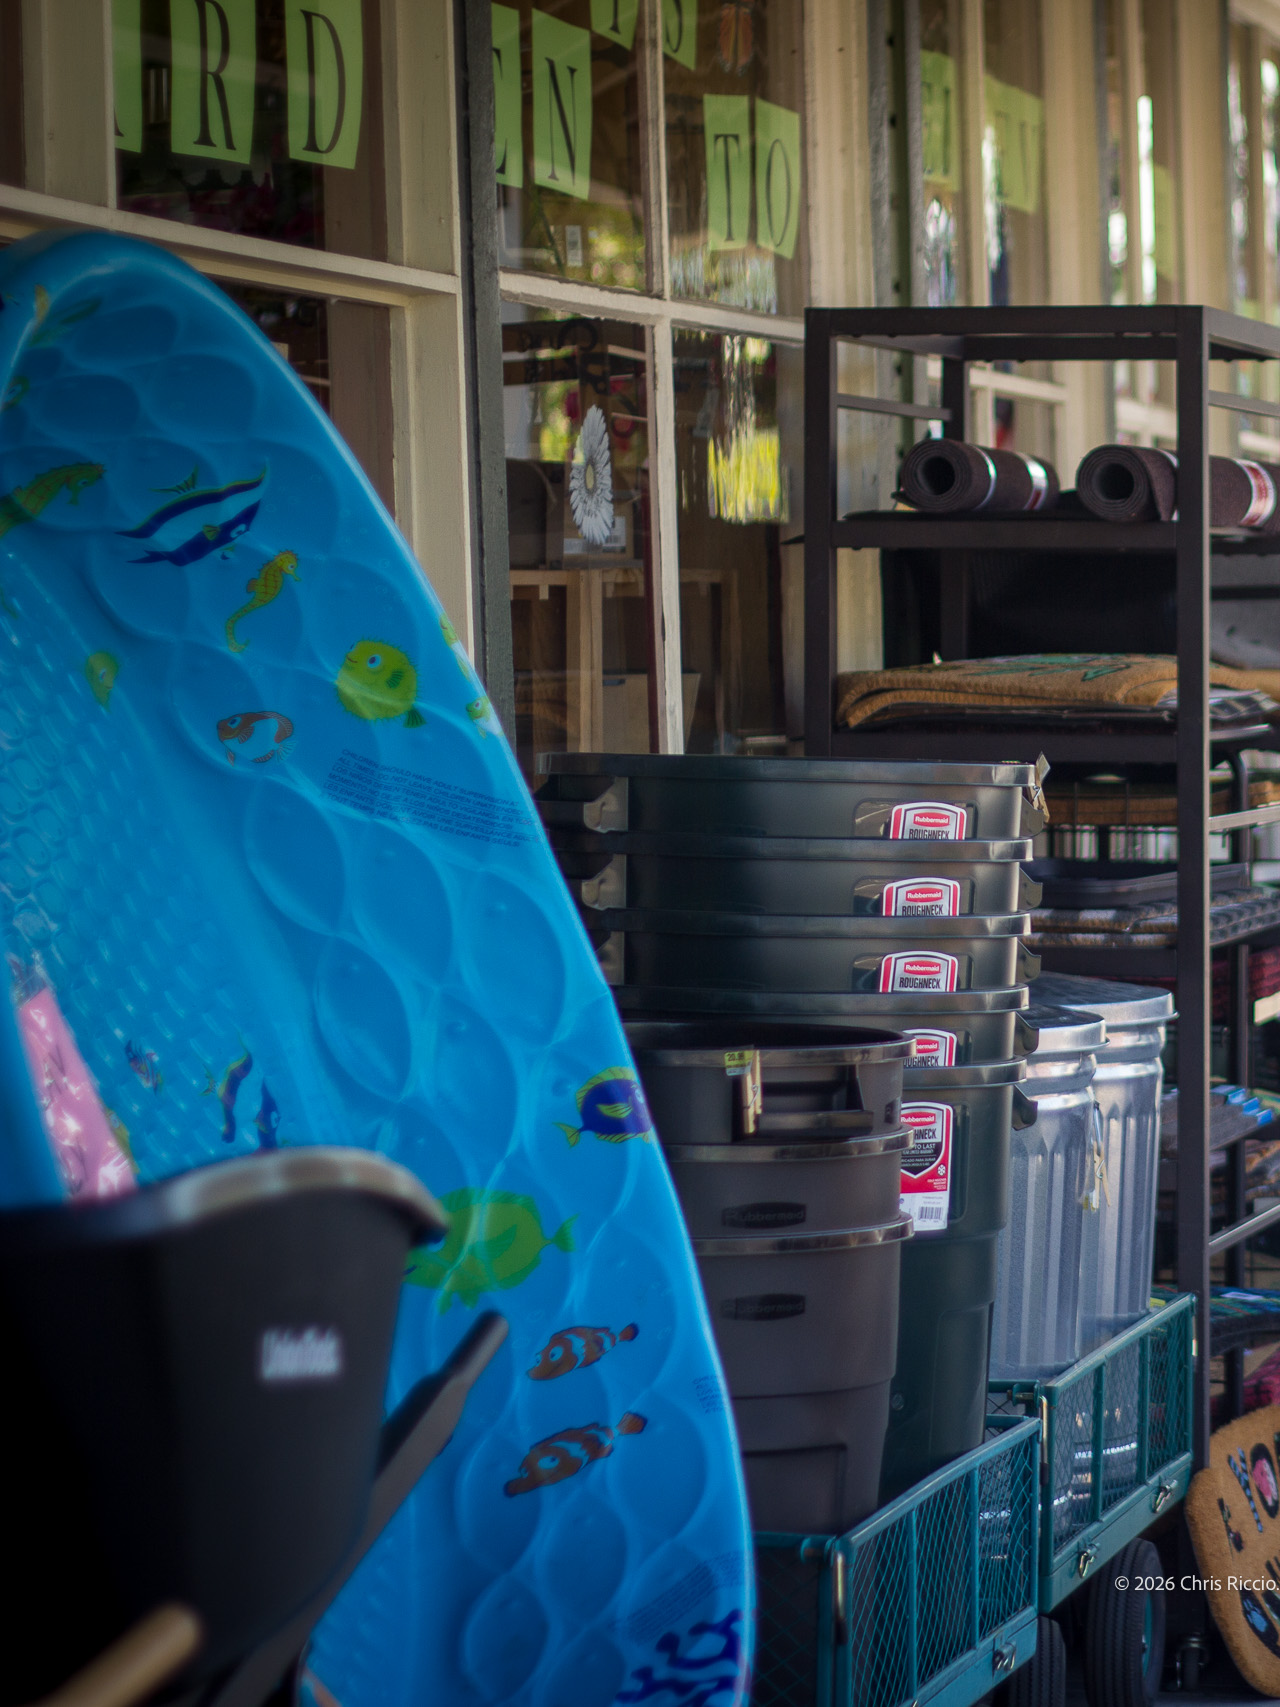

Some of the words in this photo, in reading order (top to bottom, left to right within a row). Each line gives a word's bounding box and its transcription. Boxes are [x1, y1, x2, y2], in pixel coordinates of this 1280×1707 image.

[714, 133, 791, 248] TO
[914, 816, 949, 824] Rubbermaid
[908, 828, 950, 840] ROUGHNECK
[907, 891, 942, 899] Rubbermaid
[901, 904, 944, 916] ROUGHNECK
[905, 964, 940, 972] Rubbermaid
[899, 976, 941, 989] ROUGHNECK
[903, 1055, 940, 1067] OUGHNECK
[901, 1115, 935, 1123] Rubbermaid
[914, 1128, 937, 1140] HNECK
